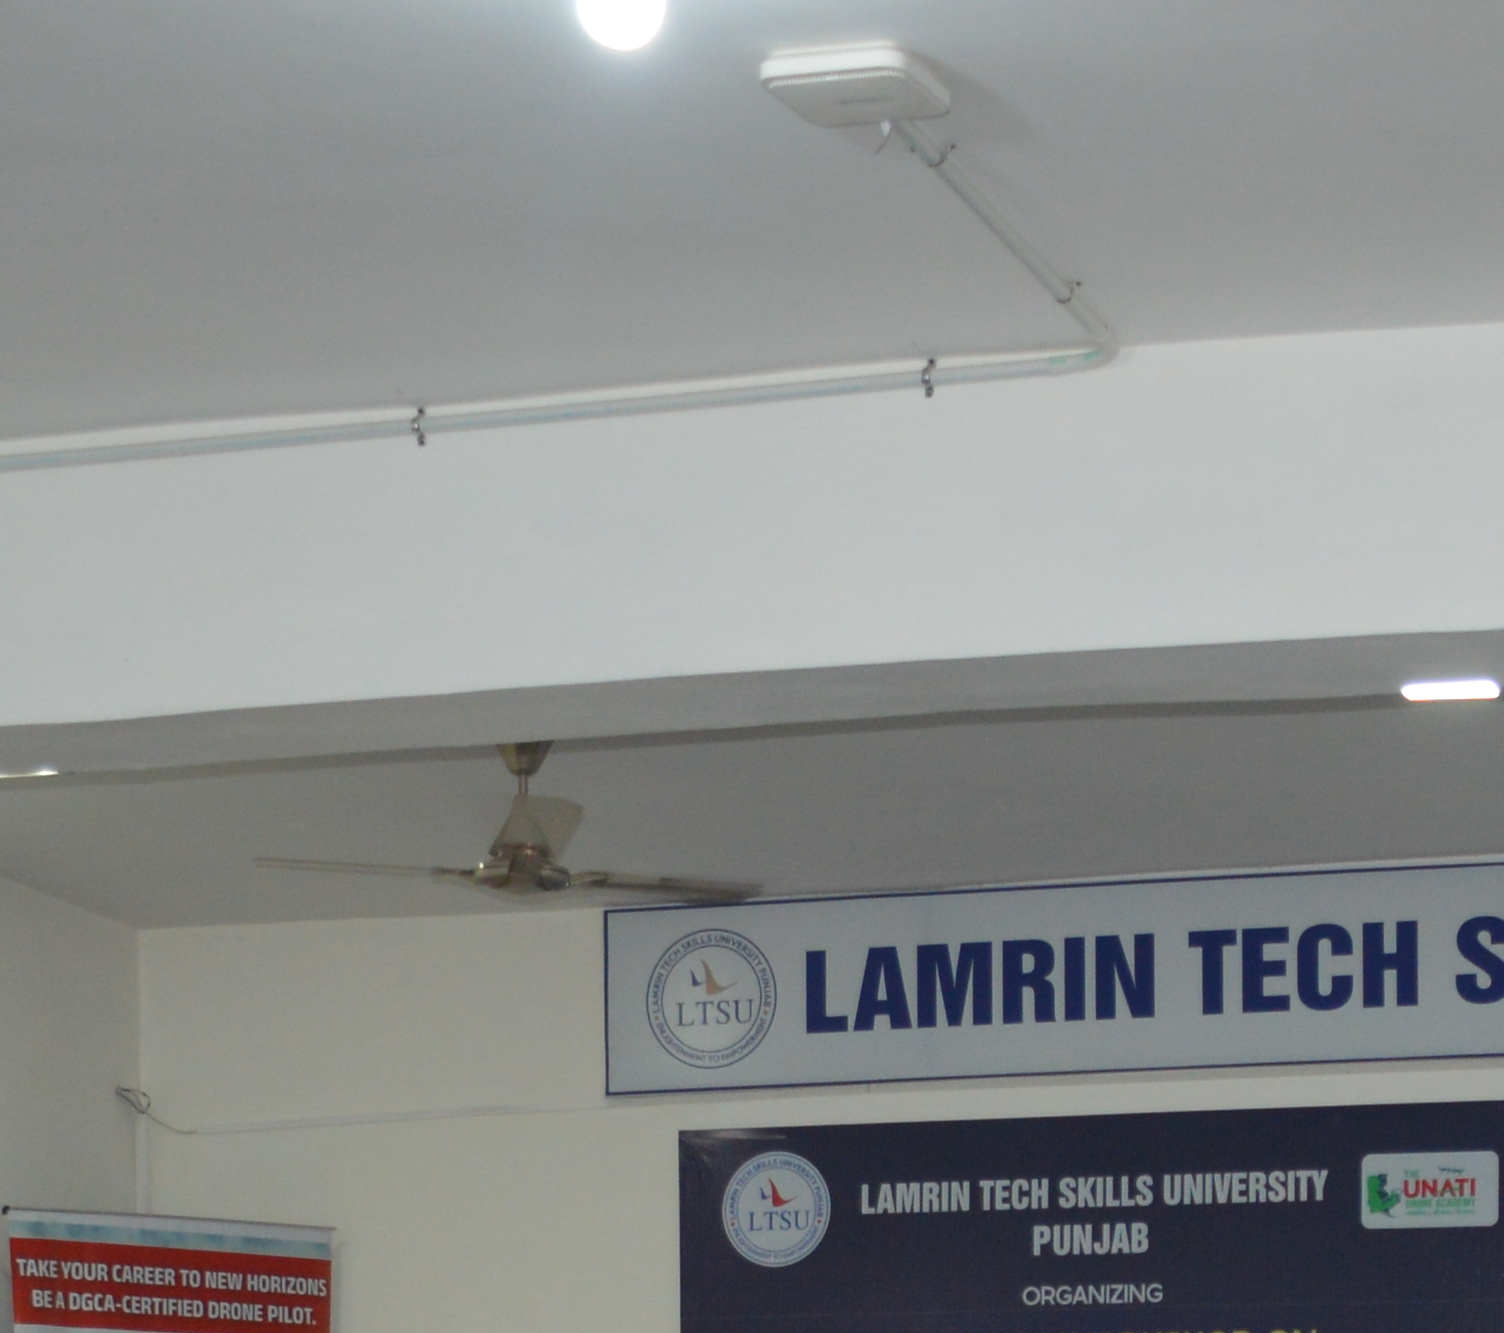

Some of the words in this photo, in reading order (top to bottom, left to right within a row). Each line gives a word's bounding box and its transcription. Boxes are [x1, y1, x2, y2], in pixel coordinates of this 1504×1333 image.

[806, 933, 1155, 1033] LAMRIN
[1188, 920, 1418, 1015] TECH
[677, 998, 754, 1027] LTSU
[861, 1181, 970, 1215] LAMRIN
[980, 1177, 1049, 1211] TECH
[1059, 1174, 1154, 1209] SKILLS
[1163, 1169, 1329, 1206] UNIVERSITY
[1403, 1178, 1476, 1198] UNATI
[749, 1210, 810, 1231] LTSU
[1032, 1222, 1149, 1256] PUNJAB
[17, 1259, 58, 1280] TAKE
[62, 1262, 108, 1282] YOUR
[112, 1265, 175, 1287] CAREER
[180, 1269, 200, 1288] TO
[205, 1271, 243, 1292] NEW
[247, 1273, 327, 1297] HORIZONS
[1022, 1283, 1163, 1306] ORGANIZING
[32, 1290, 54, 1309] BE
[55, 1291, 65, 1310] A
[69, 1293, 204, 1318] DGCA-CERTIFIED
[208, 1301, 263, 1323] DRONE
[267, 1306, 316, 1325] PILOT.
